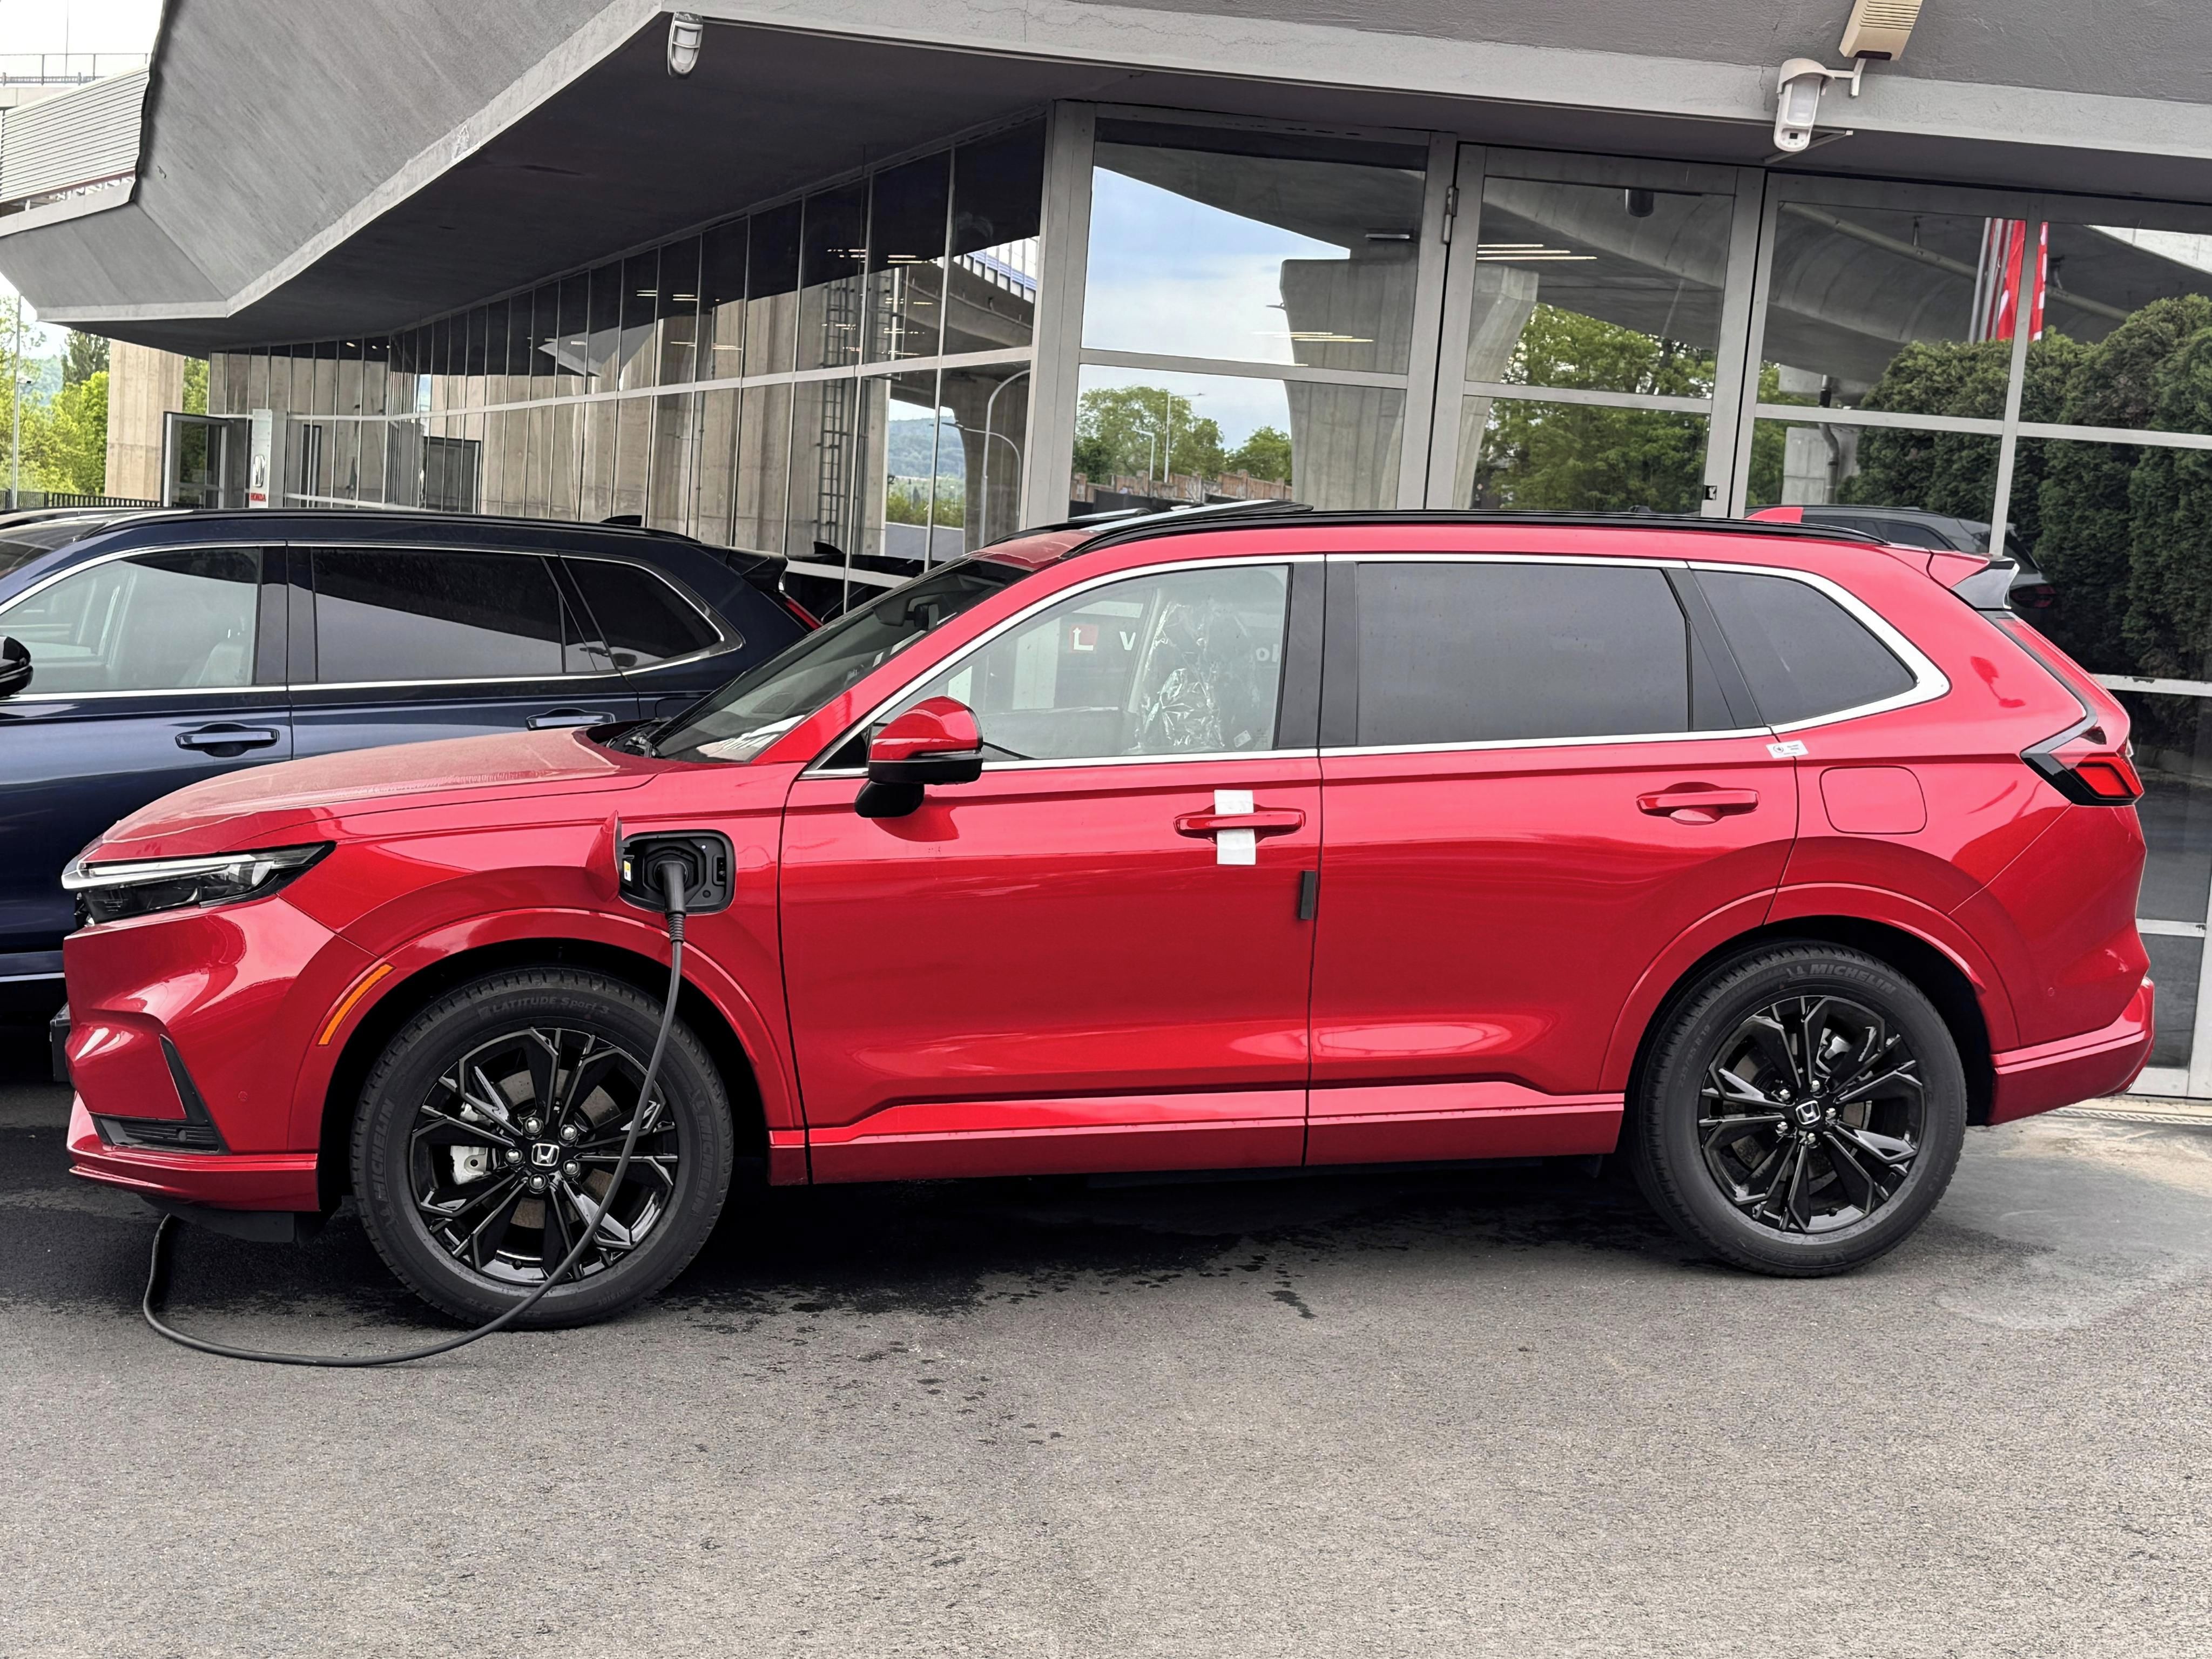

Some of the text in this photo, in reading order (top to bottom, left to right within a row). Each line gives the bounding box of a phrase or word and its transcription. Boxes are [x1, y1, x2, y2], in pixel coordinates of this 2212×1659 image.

[250, 492, 266, 502] HONDA
[1810, 964, 1897, 994] MICHELIN
[493, 996, 610, 1014] LATITUDE Sport 3
[372, 1097, 395, 1202] MICHELIN
[691, 1115, 714, 1212] MICHELIN
